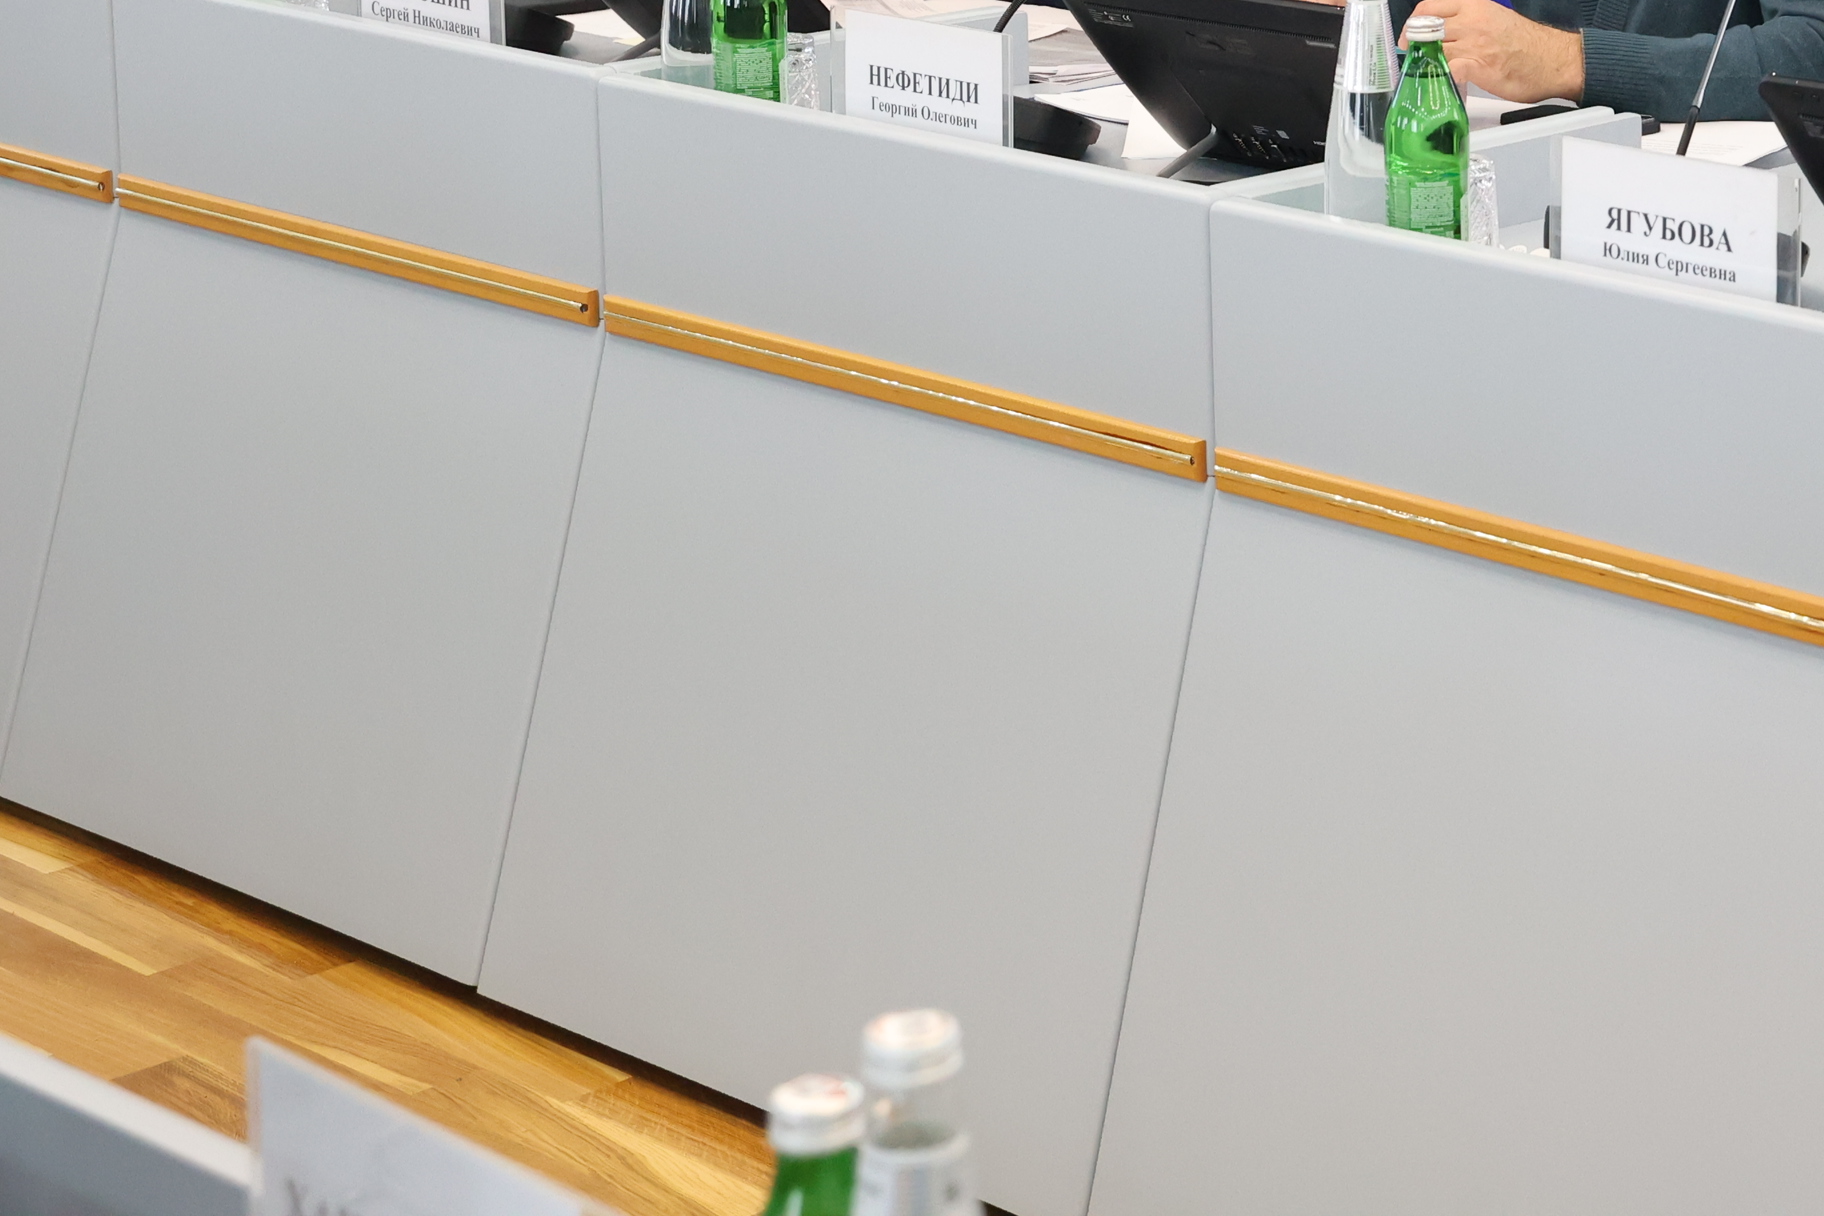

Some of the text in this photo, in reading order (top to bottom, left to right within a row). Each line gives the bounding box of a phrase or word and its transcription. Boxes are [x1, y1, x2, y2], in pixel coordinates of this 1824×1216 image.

[371, 0, 481, 38] Сергей Николаевич
[868, 64, 980, 108] НЕФЕТИДИ
[871, 95, 978, 130] Георгий Олегович
[1606, 206, 1734, 254] ЯГУБОВА
[1602, 241, 1737, 283] Юлия Сергеевна
